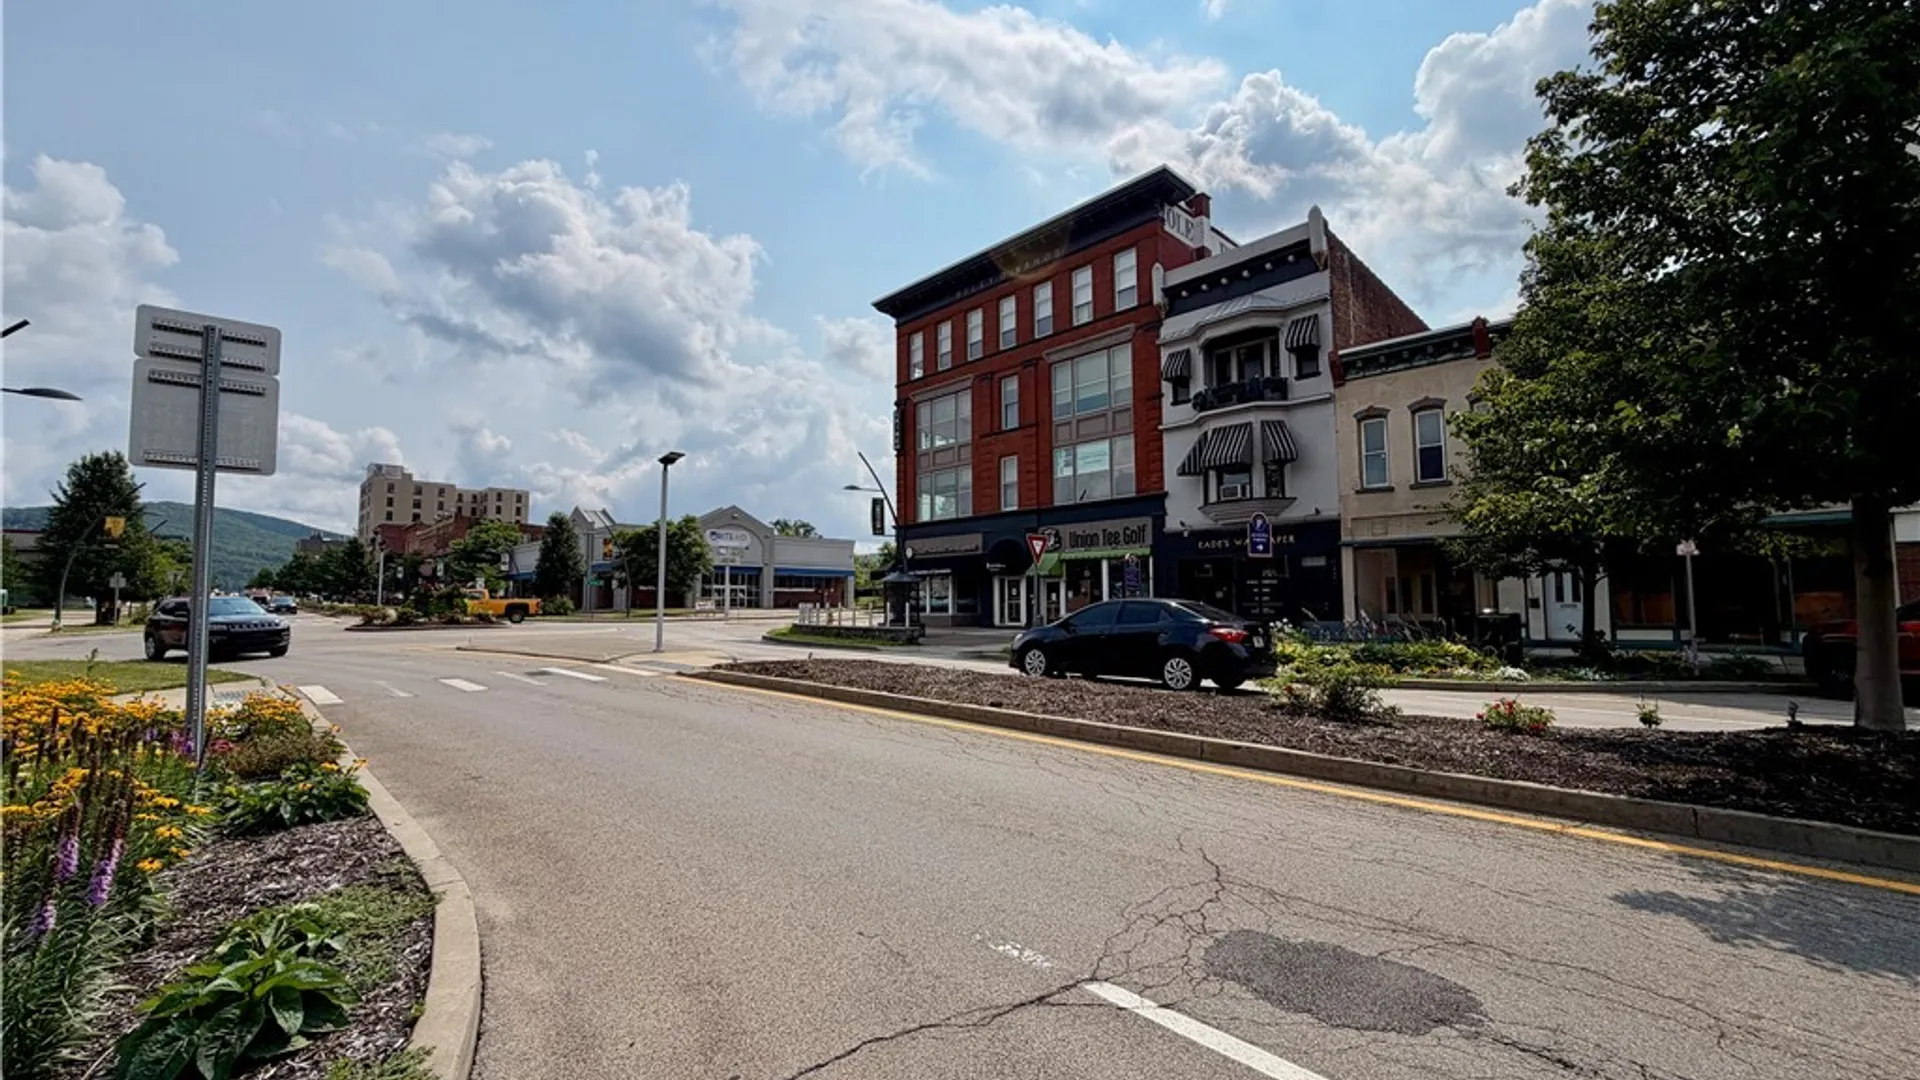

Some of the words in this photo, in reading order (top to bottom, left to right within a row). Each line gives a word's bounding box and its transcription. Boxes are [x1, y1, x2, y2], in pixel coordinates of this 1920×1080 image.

[1069, 530, 1099, 548] Union
[1102, 529, 1120, 545] Tee
[1123, 524, 1147, 545] Golf
